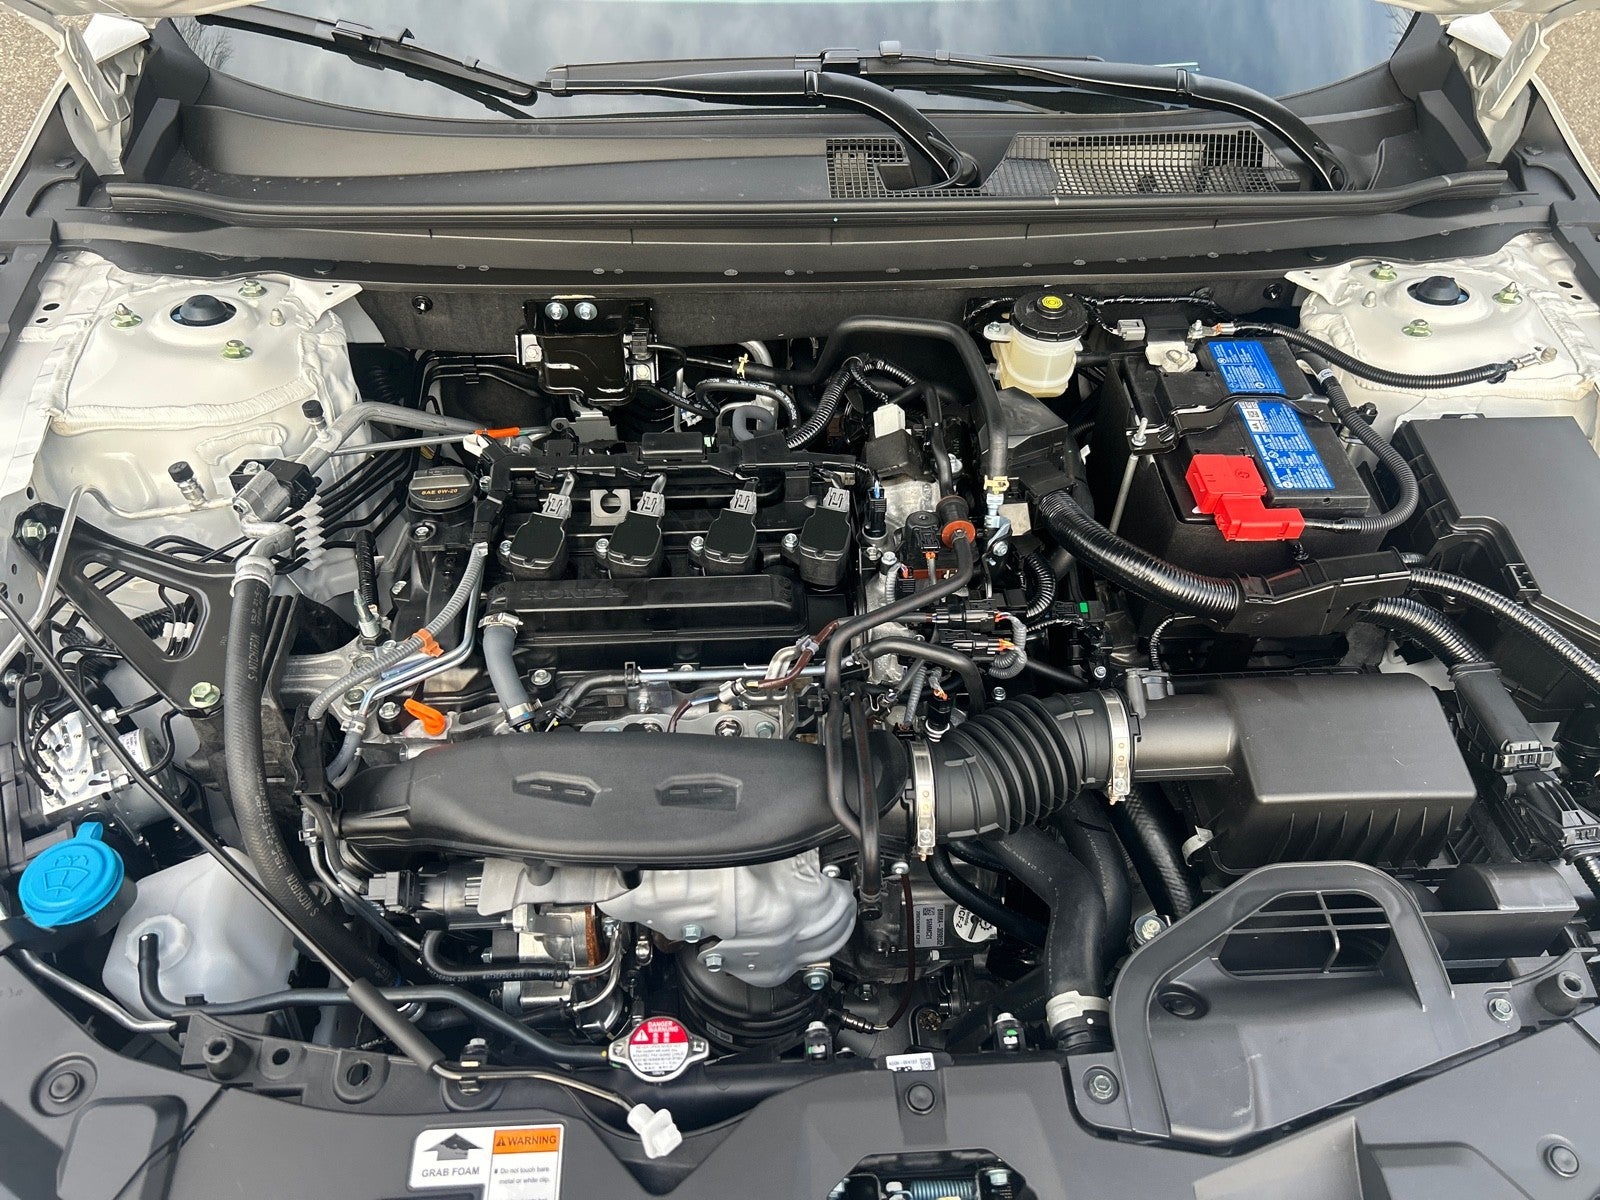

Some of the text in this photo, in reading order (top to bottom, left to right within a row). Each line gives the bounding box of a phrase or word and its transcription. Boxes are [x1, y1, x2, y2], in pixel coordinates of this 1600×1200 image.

[520, 586, 628, 600] HONDA
[507, 1135, 557, 1146] WARNING
[421, 1166, 480, 1178] GRAB FOAM
